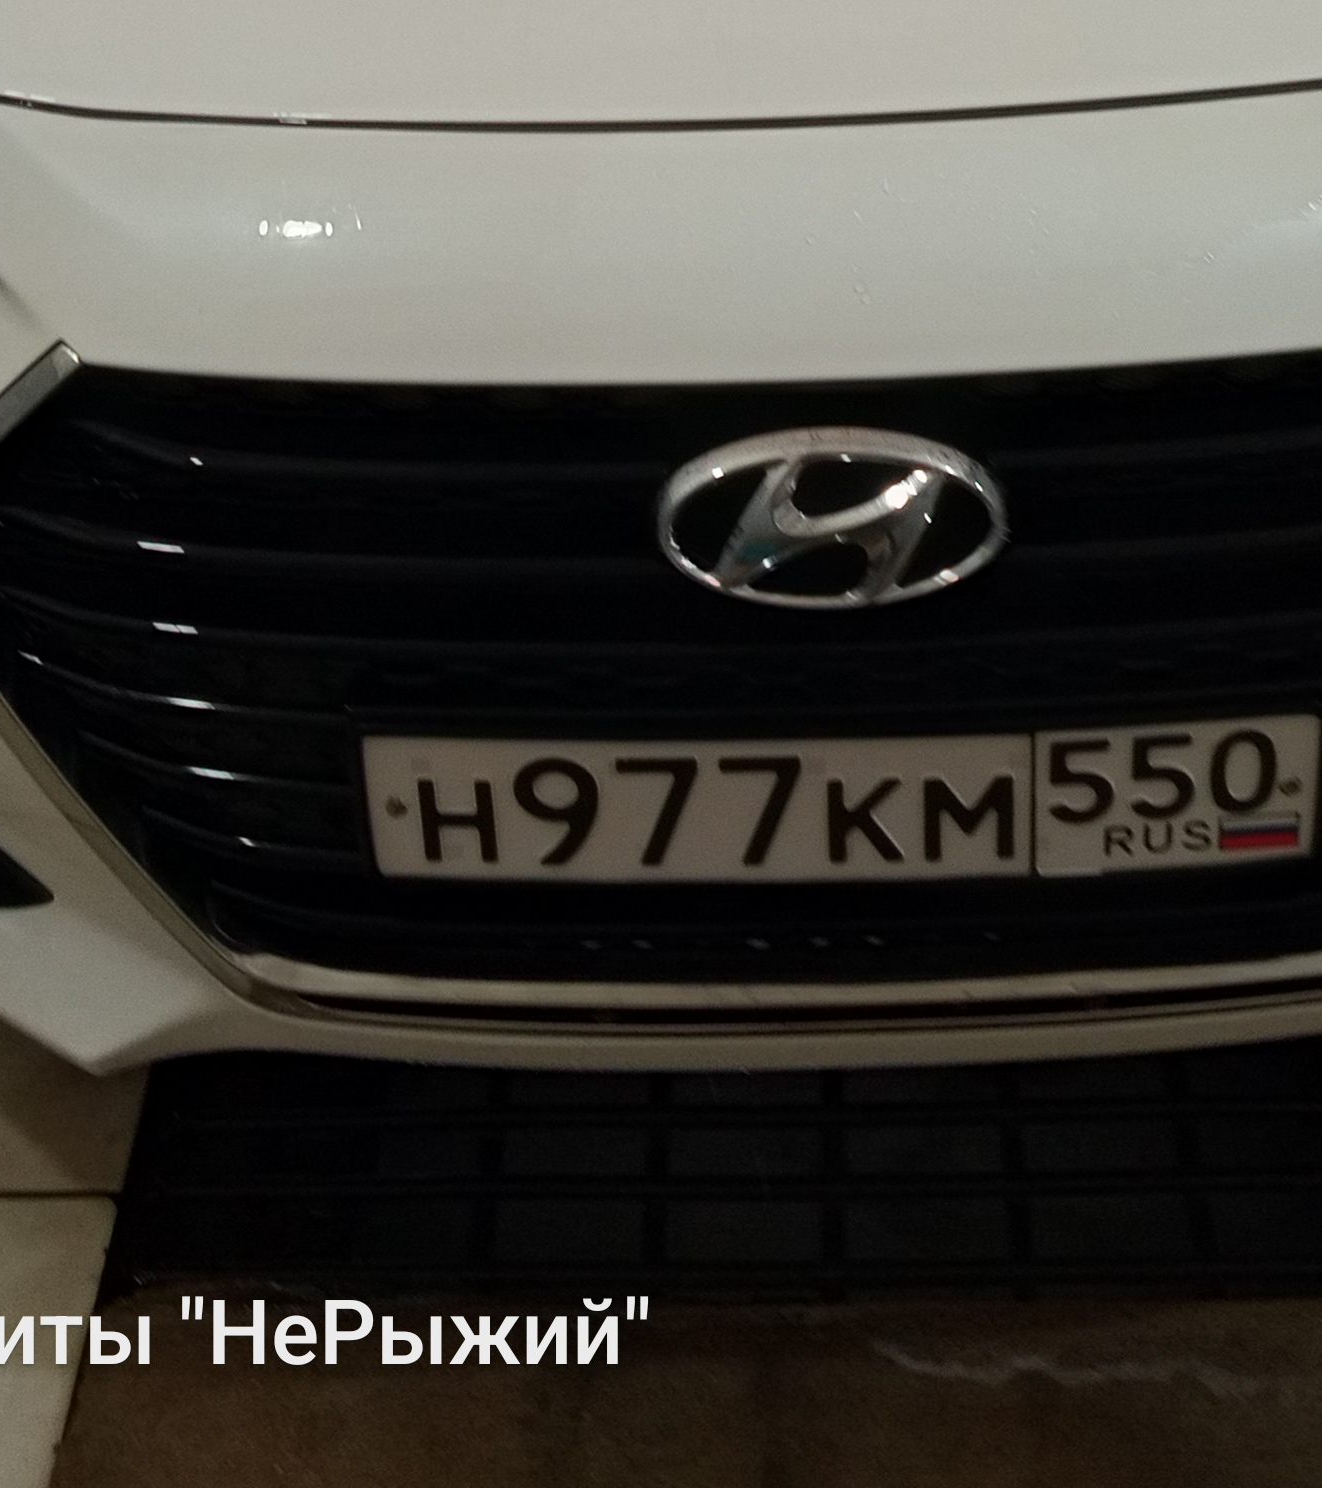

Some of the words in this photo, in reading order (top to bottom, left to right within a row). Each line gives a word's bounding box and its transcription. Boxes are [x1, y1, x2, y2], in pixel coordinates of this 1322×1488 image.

[417, 756, 1016, 867] Н977КМ
[1048, 729, 1279, 824] 550
[1103, 818, 1214, 857] RUS
